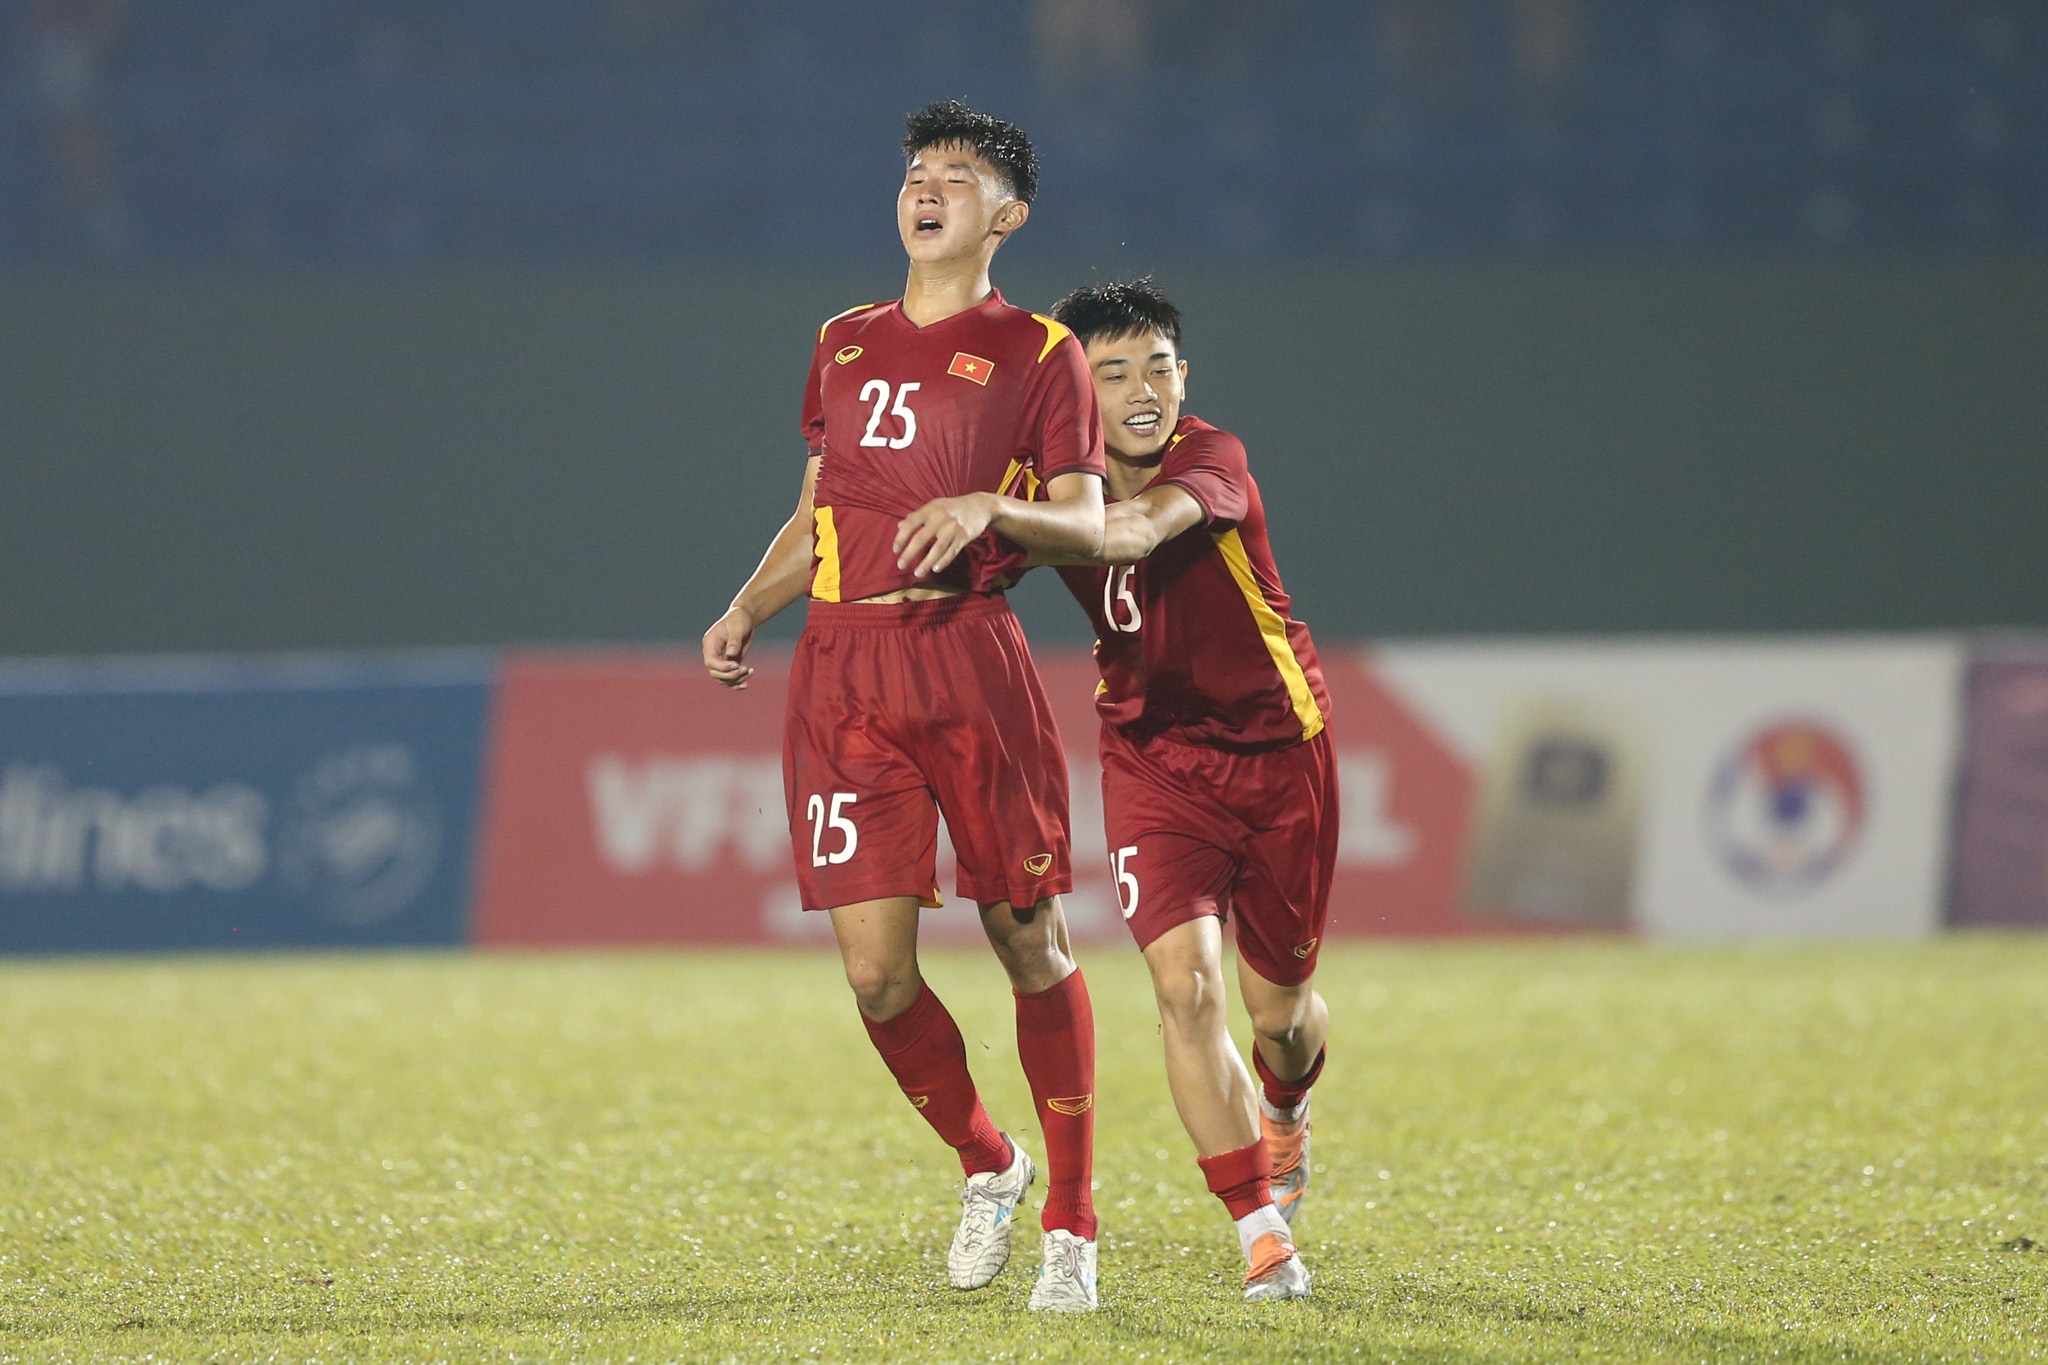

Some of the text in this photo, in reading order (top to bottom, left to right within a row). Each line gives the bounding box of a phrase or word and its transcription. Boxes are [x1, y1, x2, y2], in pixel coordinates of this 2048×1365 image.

[858, 379, 922, 450] 25
[1103, 564, 1142, 633] 15
[806, 792, 859, 868] 25
[1109, 845, 1140, 921] 15
